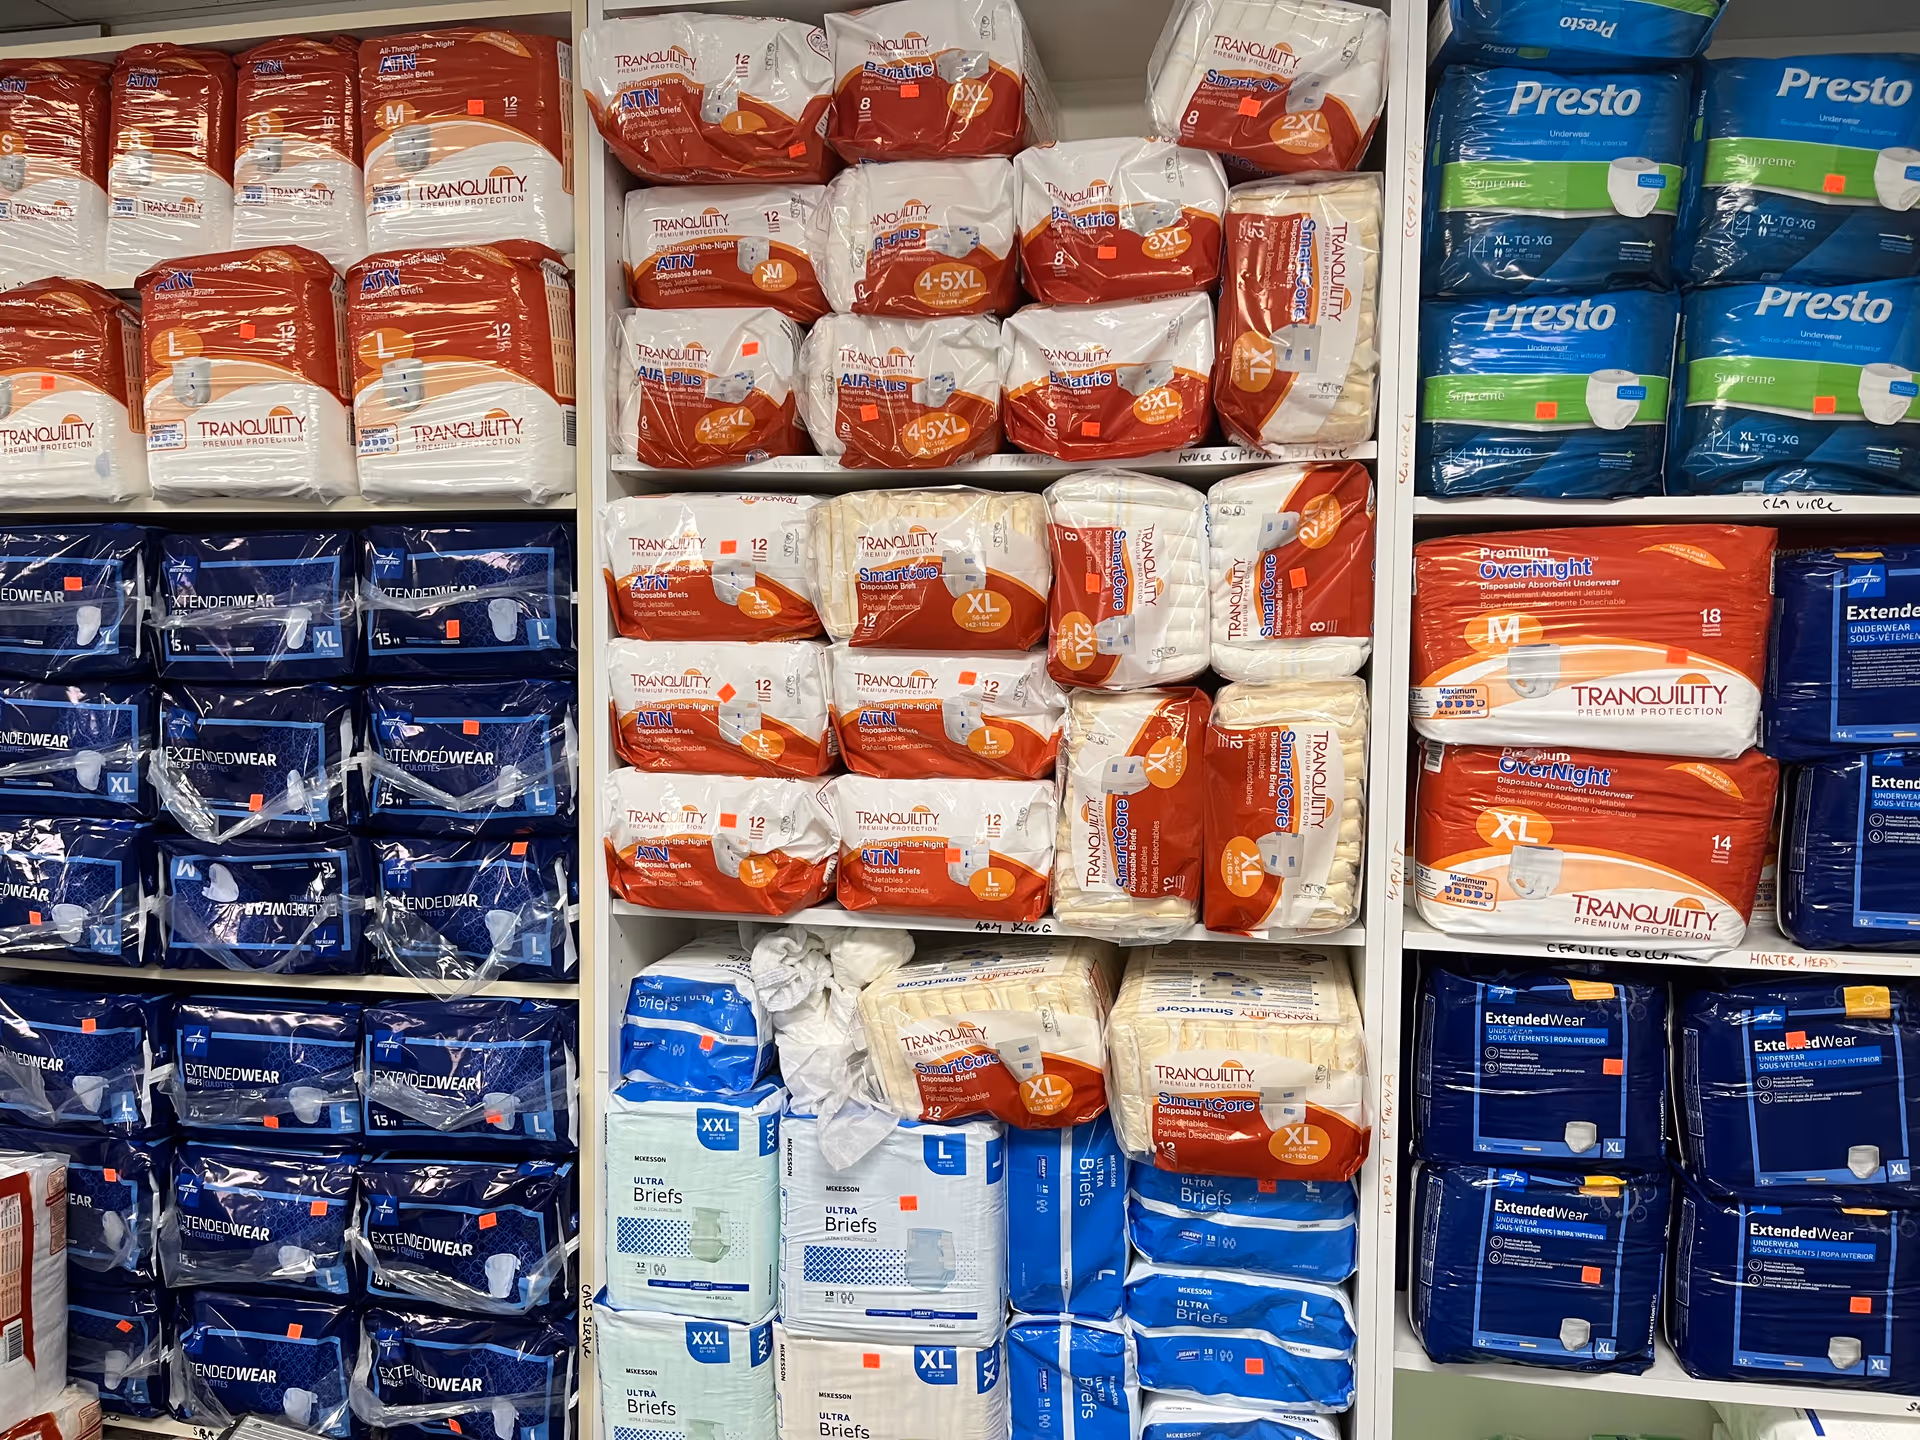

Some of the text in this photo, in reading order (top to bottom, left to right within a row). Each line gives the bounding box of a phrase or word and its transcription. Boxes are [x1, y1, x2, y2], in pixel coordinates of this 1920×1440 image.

[1560, 16, 1618, 39] Presto
[863, 60, 935, 79] Bariatric
[1776, 67, 1914, 107] Presto
[503, 97, 518, 109] 12
[620, 88, 659, 110] ATN
[859, 97, 872, 110] 8
[1508, 81, 1641, 116] Presto
[386, 104, 404, 123] M
[1187, 110, 1199, 125] 8
[1282, 114, 1326, 133] 2XL
[1549, 130, 1590, 138] Underwear
[421, 195, 524, 210] PREMIUM PROTECTION
[764, 211, 779, 222] 12
[1148, 227, 1187, 250] 3XL
[657, 254, 694, 271] ATN
[156, 271, 194, 291] ATN
[920, 270, 981, 290] 4-5XL
[1754, 286, 1893, 323] Presto
[1483, 299, 1616, 332] Presto
[1800, 331, 1842, 340] Underwear
[168, 332, 184, 357] L
[377, 333, 394, 358] L
[1251, 347, 1272, 381] XL
[1139, 391, 1178, 412] 3XL
[197, 416, 306, 438] TRANQUILITY
[640, 416, 648, 430] 8
[907, 416, 966, 442] 4-5XL
[1047, 414, 1056, 428] 8
[410, 418, 523, 442] TRANQUILITY
[202, 435, 304, 448] PREMIUM PROTECTION
[751, 538, 767, 551] 12
[1065, 531, 1077, 542] 8
[1480, 547, 1548, 560] Premium
[859, 564, 938, 584] SmartCore
[1479, 558, 1592, 581] OverNight
[860, 581, 917, 592] Disposable Briefs
[1480, 579, 1620, 591] Disposable Absorbent Underwear
[631, 591, 688, 600] Disposable Briefs
[967, 593, 1000, 613] XL
[1260, 554, 1276, 637] SmartCore
[1700, 609, 1721, 623] 18
[1310, 621, 1325, 632] 8
[1487, 618, 1520, 644] M
[1850, 623, 1911, 633] UNDERWEAR
[316, 631, 339, 648] XL
[376, 632, 391, 646] 15
[1073, 622, 1092, 664] 2XL
[630, 673, 710, 688] TRANQUILITY
[756, 680, 771, 692] 12
[855, 673, 936, 690] TRANQUILITY
[1439, 687, 1477, 696] Maximum
[1571, 685, 1727, 708] TRANQUILITY
[636, 711, 673, 727] ATN
[859, 711, 897, 727] ATN
[1578, 707, 1723, 717] PREMIUM PROTECTION
[985, 730, 997, 746] L
[1836, 731, 1847, 739] 14
[165, 746, 277, 767] EXTENDEDWEAR
[1268, 731, 1279, 797] Disposable Briefs
[1276, 731, 1296, 827] SmartCore
[1499, 757, 1610, 786] OverNight
[111, 776, 135, 793] XL
[535, 788, 547, 805] L
[749, 816, 765, 829] 12
[856, 810, 939, 828] TRANQUILITY
[985, 814, 1002, 828] 12
[891, 825, 938, 833] PROTECTION
[1490, 813, 1538, 843] XL
[1712, 835, 1732, 850] 14
[636, 845, 669, 861] ATN
[861, 849, 899, 866] ATN
[987, 871, 999, 888] L
[1449, 873, 1487, 887] Maximum
[1572, 893, 1717, 932] TRANQUILITY
[1574, 917, 1711, 941] PREMIUM PROTECTION
[531, 937, 541, 955] L
[1156, 1005, 1233, 1016] SmartCore
[1486, 1011, 1585, 1029] ExtendedWear
[1489, 1028, 1533, 1036] UNDERWEAR
[915, 1052, 1000, 1075] SmartCore
[1759, 1054, 1804, 1062] UNDERWEAR
[185, 1064, 279, 1084] EXTENDEDWEAR
[1155, 1065, 1254, 1082] TRANQUILITY
[1029, 1077, 1062, 1098] XL
[1159, 1080, 1196, 1088] PREMIUM
[1158, 1091, 1255, 1113] SmartCore
[703, 1119, 733, 1132] XXL
[766, 1118, 776, 1148] XXL
[1284, 1127, 1318, 1145] XL
[1606, 1141, 1622, 1153] XL
[1891, 1163, 1907, 1176] XL
[634, 1176, 664, 1186] ULTRA
[1181, 1177, 1214, 1188] ULTRA
[633, 1187, 683, 1205] Briefs
[1181, 1188, 1232, 1207] Briefs
[825, 1206, 858, 1216] ULTRA
[1494, 1199, 1588, 1221] ExtendedWear
[825, 1217, 877, 1234] Briefs
[1750, 1223, 1854, 1242] ExtendedWear
[1753, 1240, 1799, 1249] UNDERWEAR
[1177, 1300, 1209, 1311] ULTRA
[1301, 1301, 1313, 1321] L
[1176, 1309, 1228, 1324] Briefs
[691, 1331, 724, 1346] XXL
[1204, 1348, 1214, 1356] 18
[1597, 1342, 1612, 1354] XL
[1871, 1359, 1887, 1371] XL
[627, 1389, 657, 1399] ULTRA
[627, 1399, 676, 1417] Briefs
[819, 1412, 850, 1422] ULTRA
